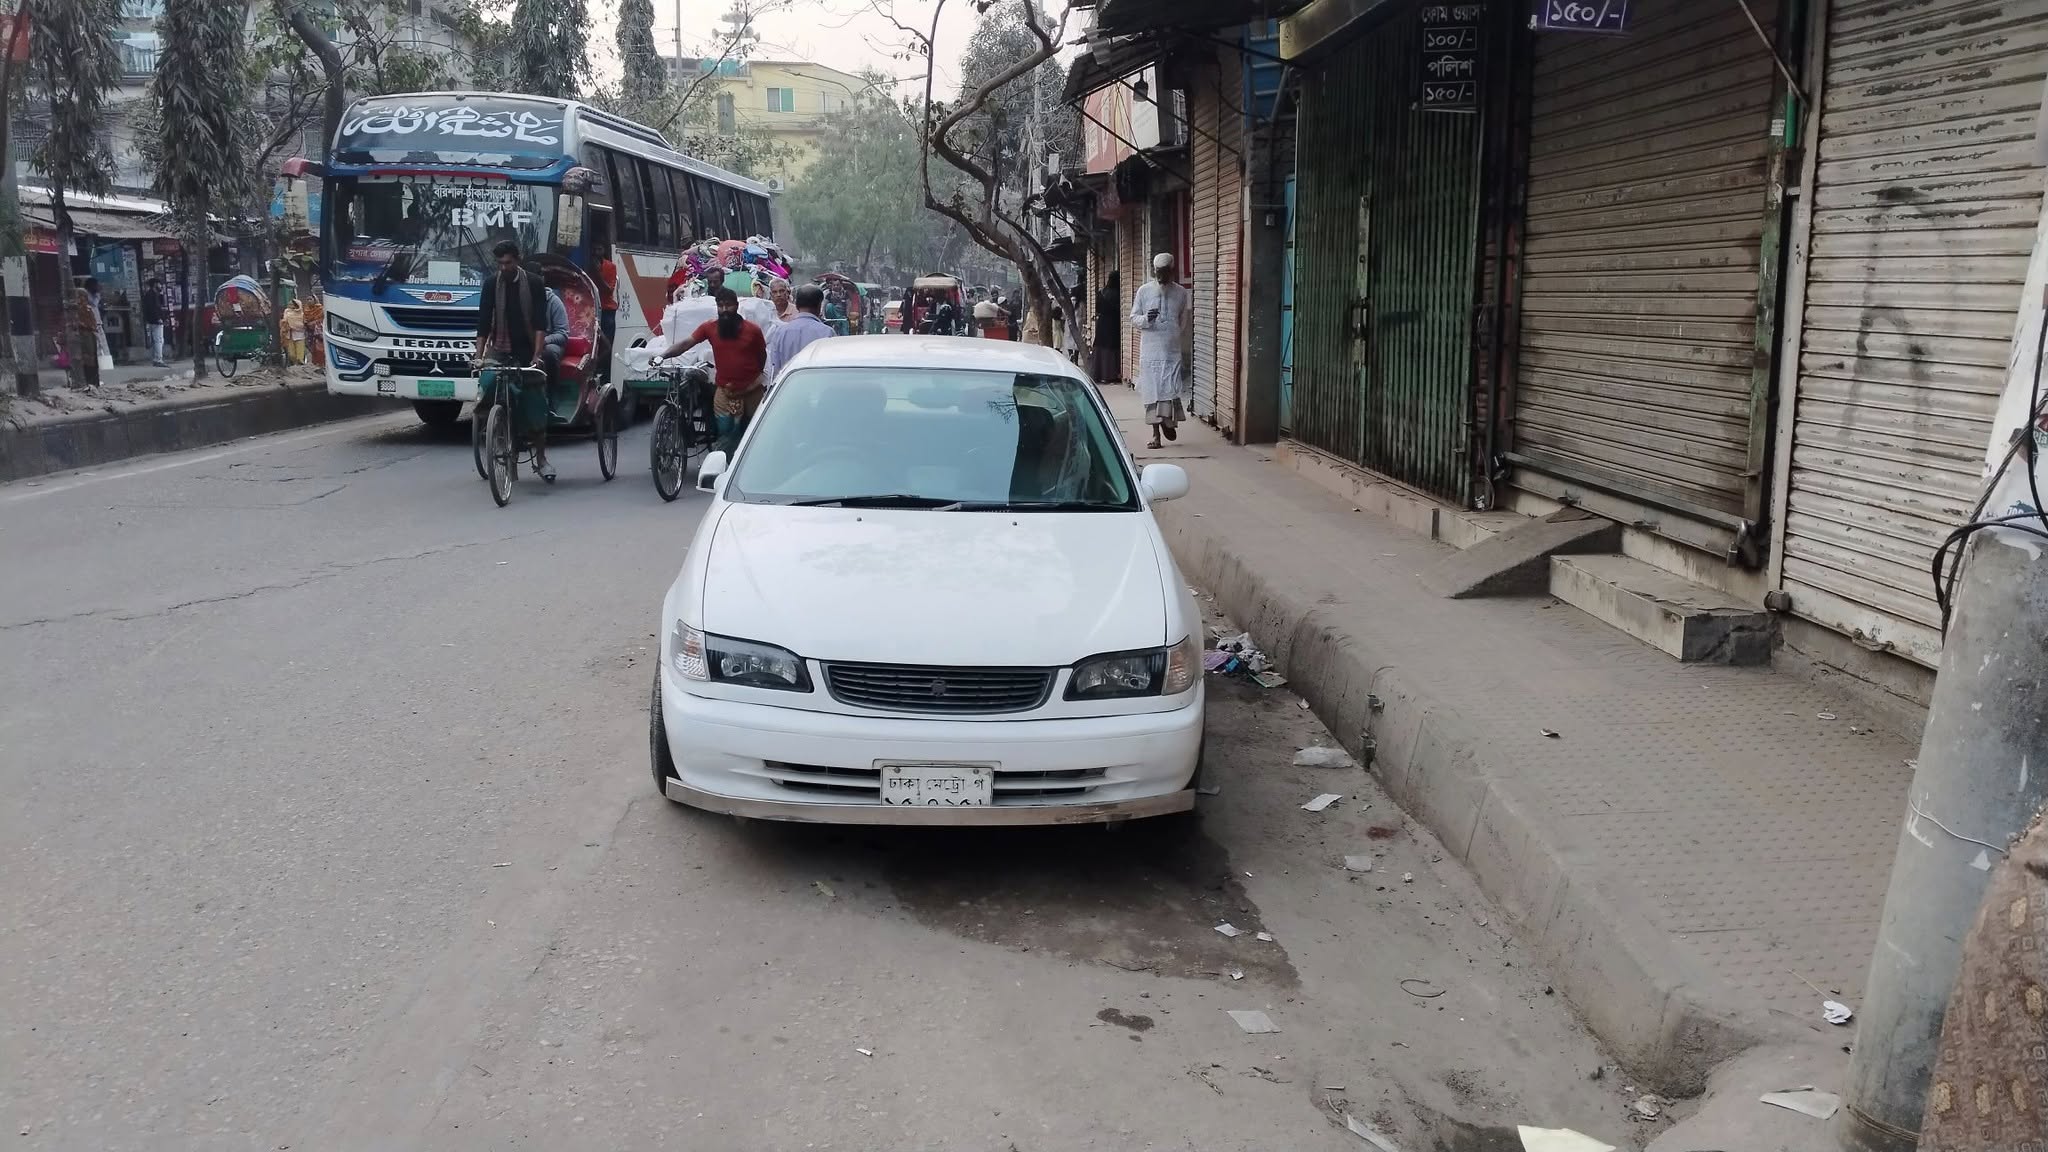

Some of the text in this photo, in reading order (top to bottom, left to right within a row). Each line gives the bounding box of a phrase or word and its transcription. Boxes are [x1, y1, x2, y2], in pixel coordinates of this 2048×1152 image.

[1427, 29, 1473, 49] ১০০/-
[1427, 55, 1475, 78] পলিশ
[1426, 83, 1473, 102] ১৫০/-
[889, 778, 920, 794] ঢাকা
